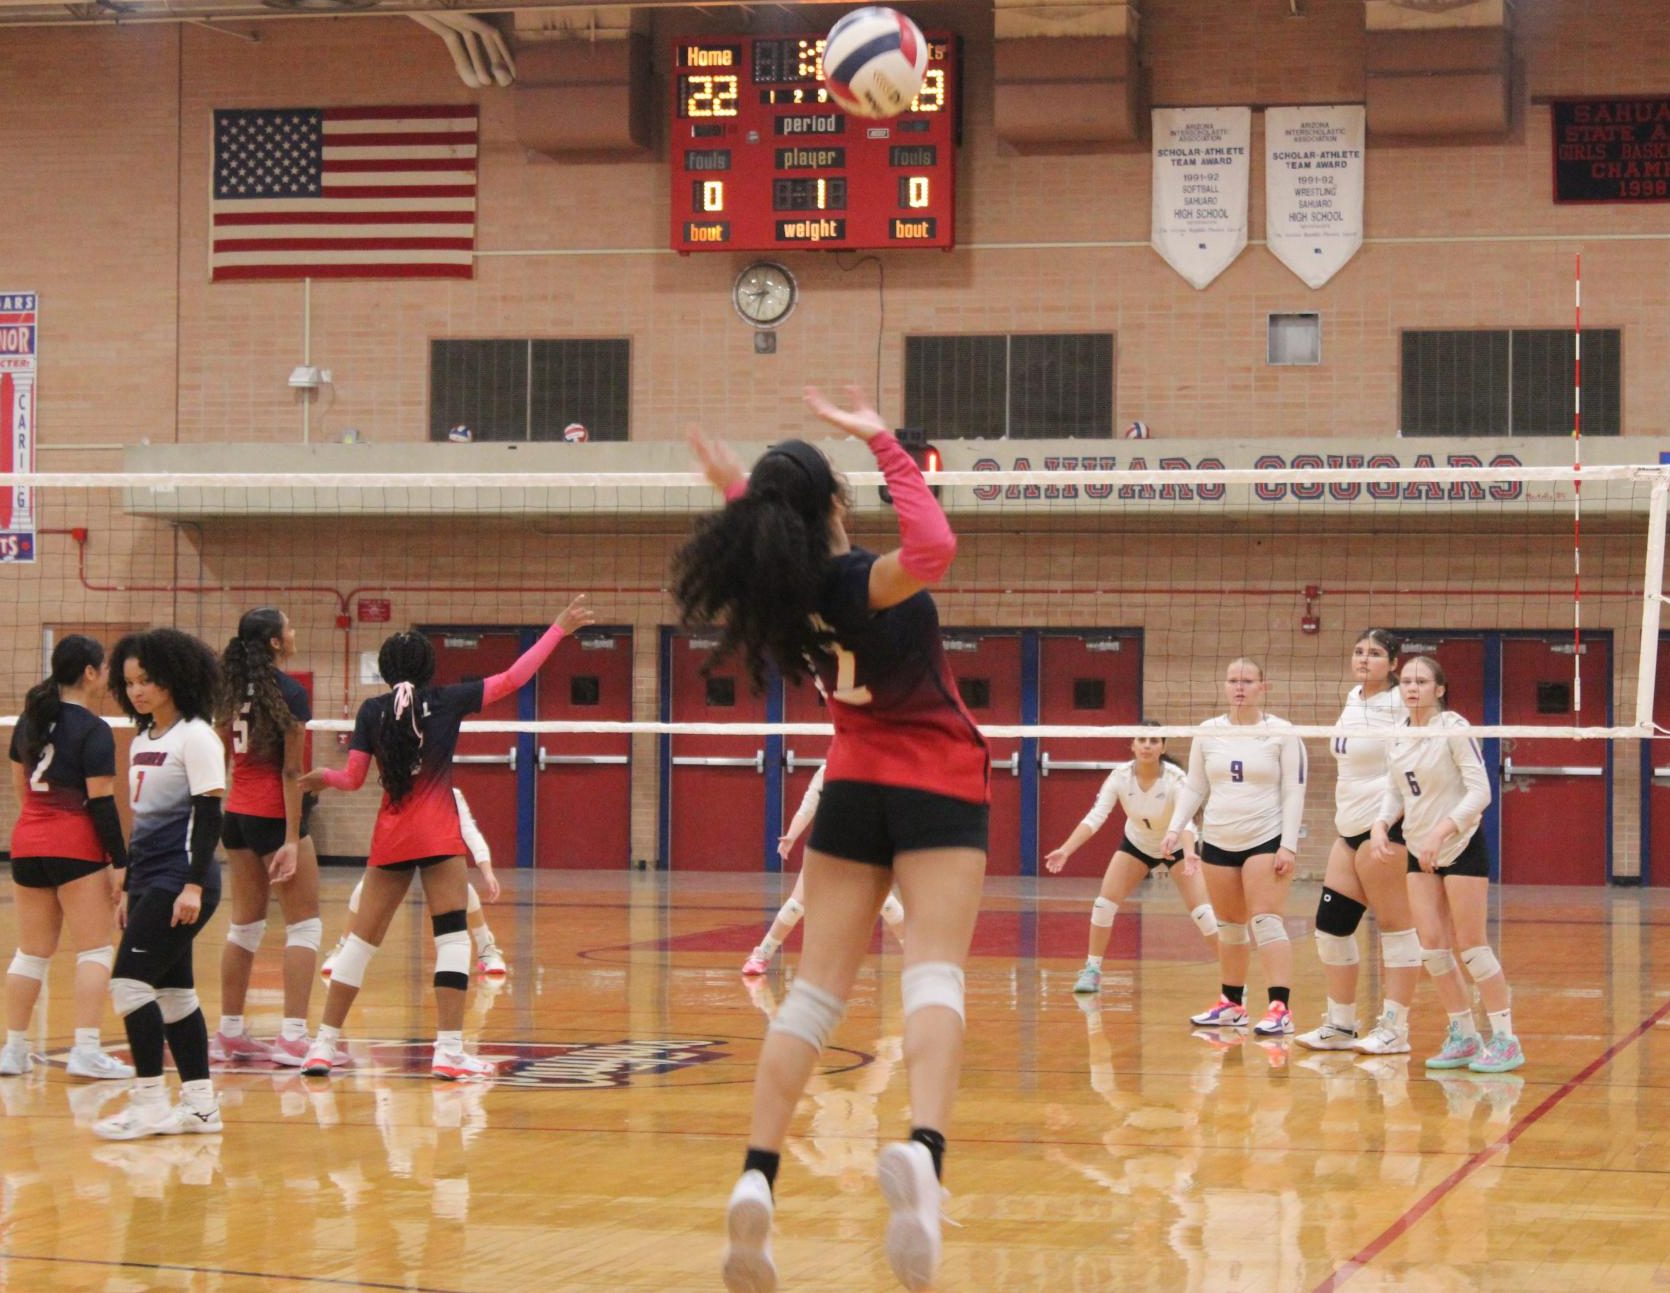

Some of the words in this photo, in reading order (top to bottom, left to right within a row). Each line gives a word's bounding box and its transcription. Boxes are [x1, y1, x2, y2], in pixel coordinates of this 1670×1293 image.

[688, 47, 733, 66] Home
[688, 75, 737, 116] 22
[794, 89, 803, 104] 2
[783, 114, 835, 135] period
[784, 149, 835, 169] player
[895, 149, 931, 166] fouls
[1158, 147, 1244, 157] SCHOLAR-ATHLETE
[1272, 150, 1360, 160] SCHOLAR-ATHLETE
[689, 153, 726, 169] fouls
[1201, 157, 1232, 166] AWARD
[1286, 161, 1311, 169] TEAM
[1316, 161, 1347, 169] AWARD
[1184, 173, 1219, 182] 1991-92
[1298, 176, 1334, 185] 1991-92
[704, 180, 723, 212] 0
[817, 178, 825, 209] 1
[909, 177, 929, 208] 0
[1182, 185, 1219, 193] SOFTBALL
[1295, 187, 1336, 196] WRESTLING
[1184, 197, 1218, 205] SAHUARO
[1298, 200, 1332, 208] SAHUARO
[1174, 209, 1193, 219] HIGH
[1196, 208, 1228, 218] SCHOOL
[1289, 212, 1307, 222] HIGH
[1311, 211, 1343, 221] SCHOOL
[690, 224, 723, 241] bout
[784, 220, 837, 241] weight
[896, 220, 929, 238] bout
[973, 457, 1226, 500] SAHUARO
[1254, 455, 1522, 500] COUGARS
[30, 742, 55, 792] 2
[1231, 760, 1244, 783] 9
[1404, 771, 1422, 797] 6
